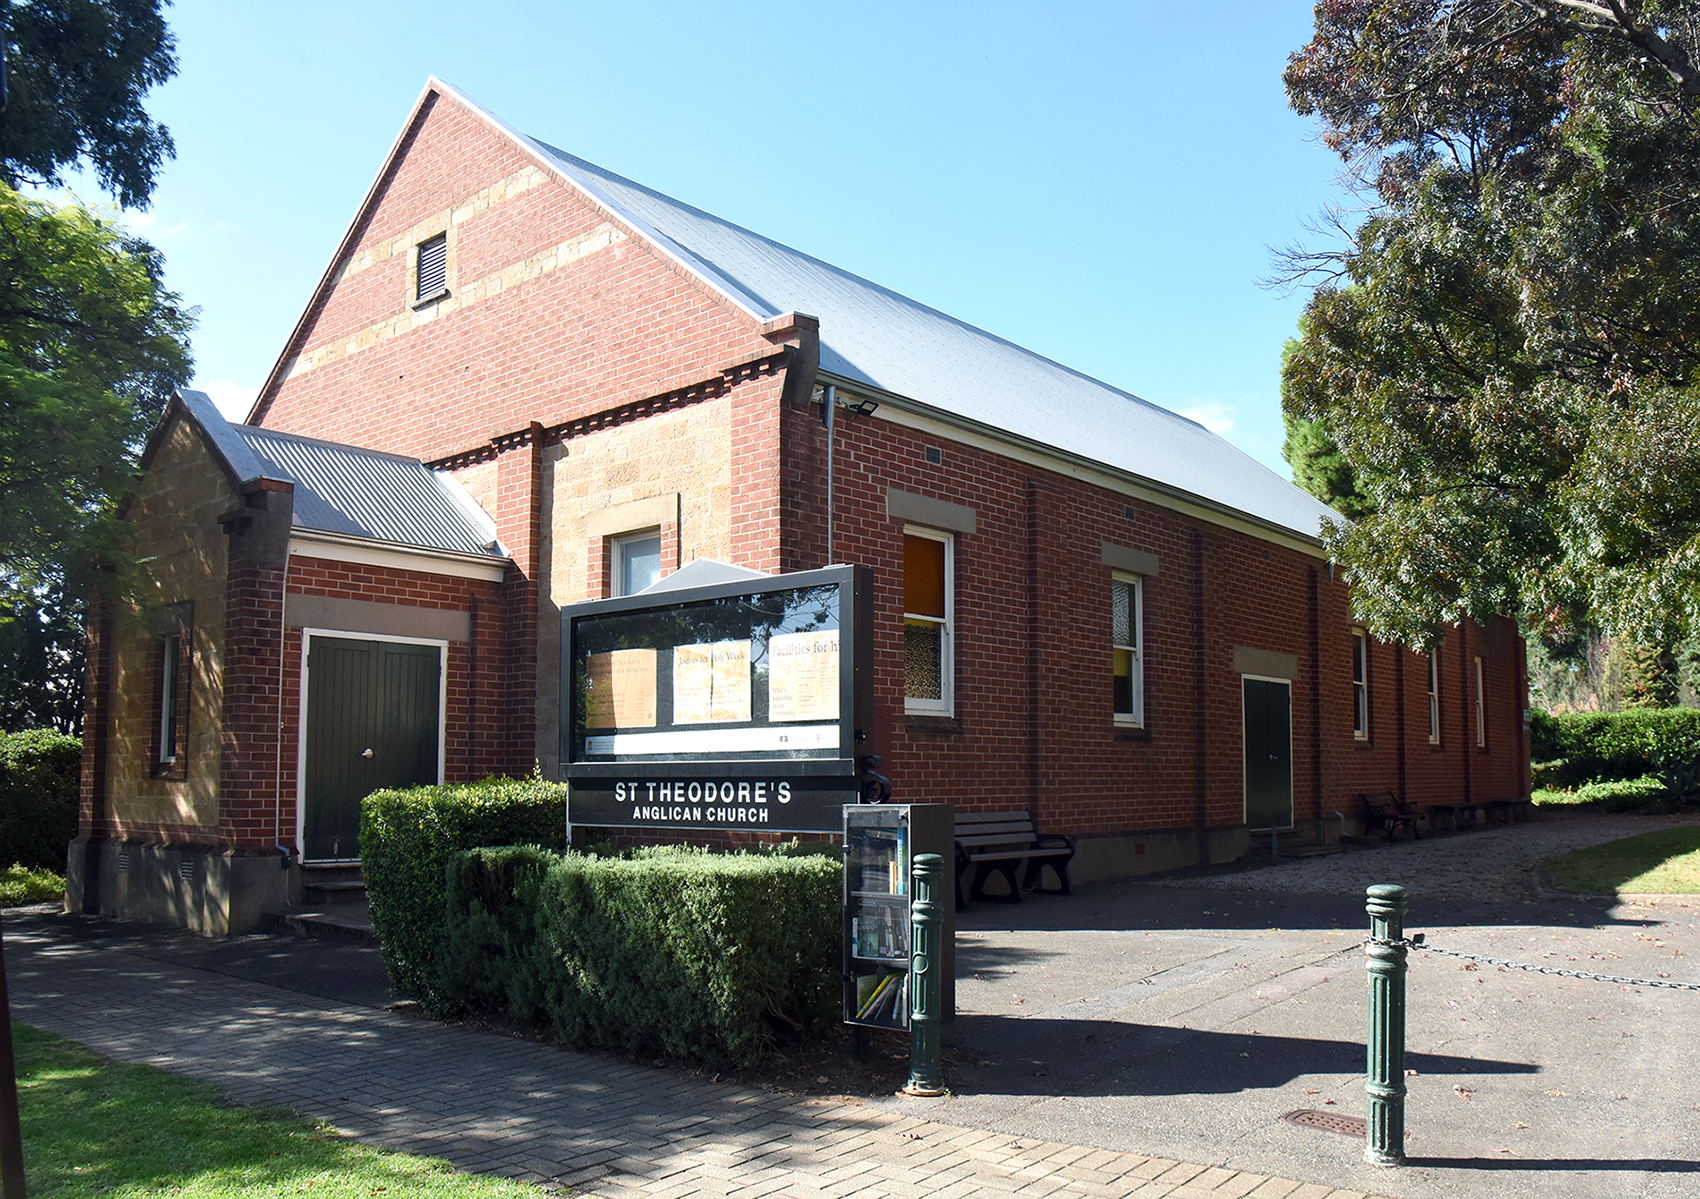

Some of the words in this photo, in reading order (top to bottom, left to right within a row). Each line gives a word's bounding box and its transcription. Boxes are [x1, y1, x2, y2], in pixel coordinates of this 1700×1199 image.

[726, 651, 745, 660] Week
[772, 643, 811, 657] Facilities
[813, 641, 828, 653] for
[615, 781, 638, 802] ST
[646, 781, 792, 804] THEODORE'S
[633, 806, 701, 821] ANGLICAN
[706, 806, 768, 823] CHURCH
